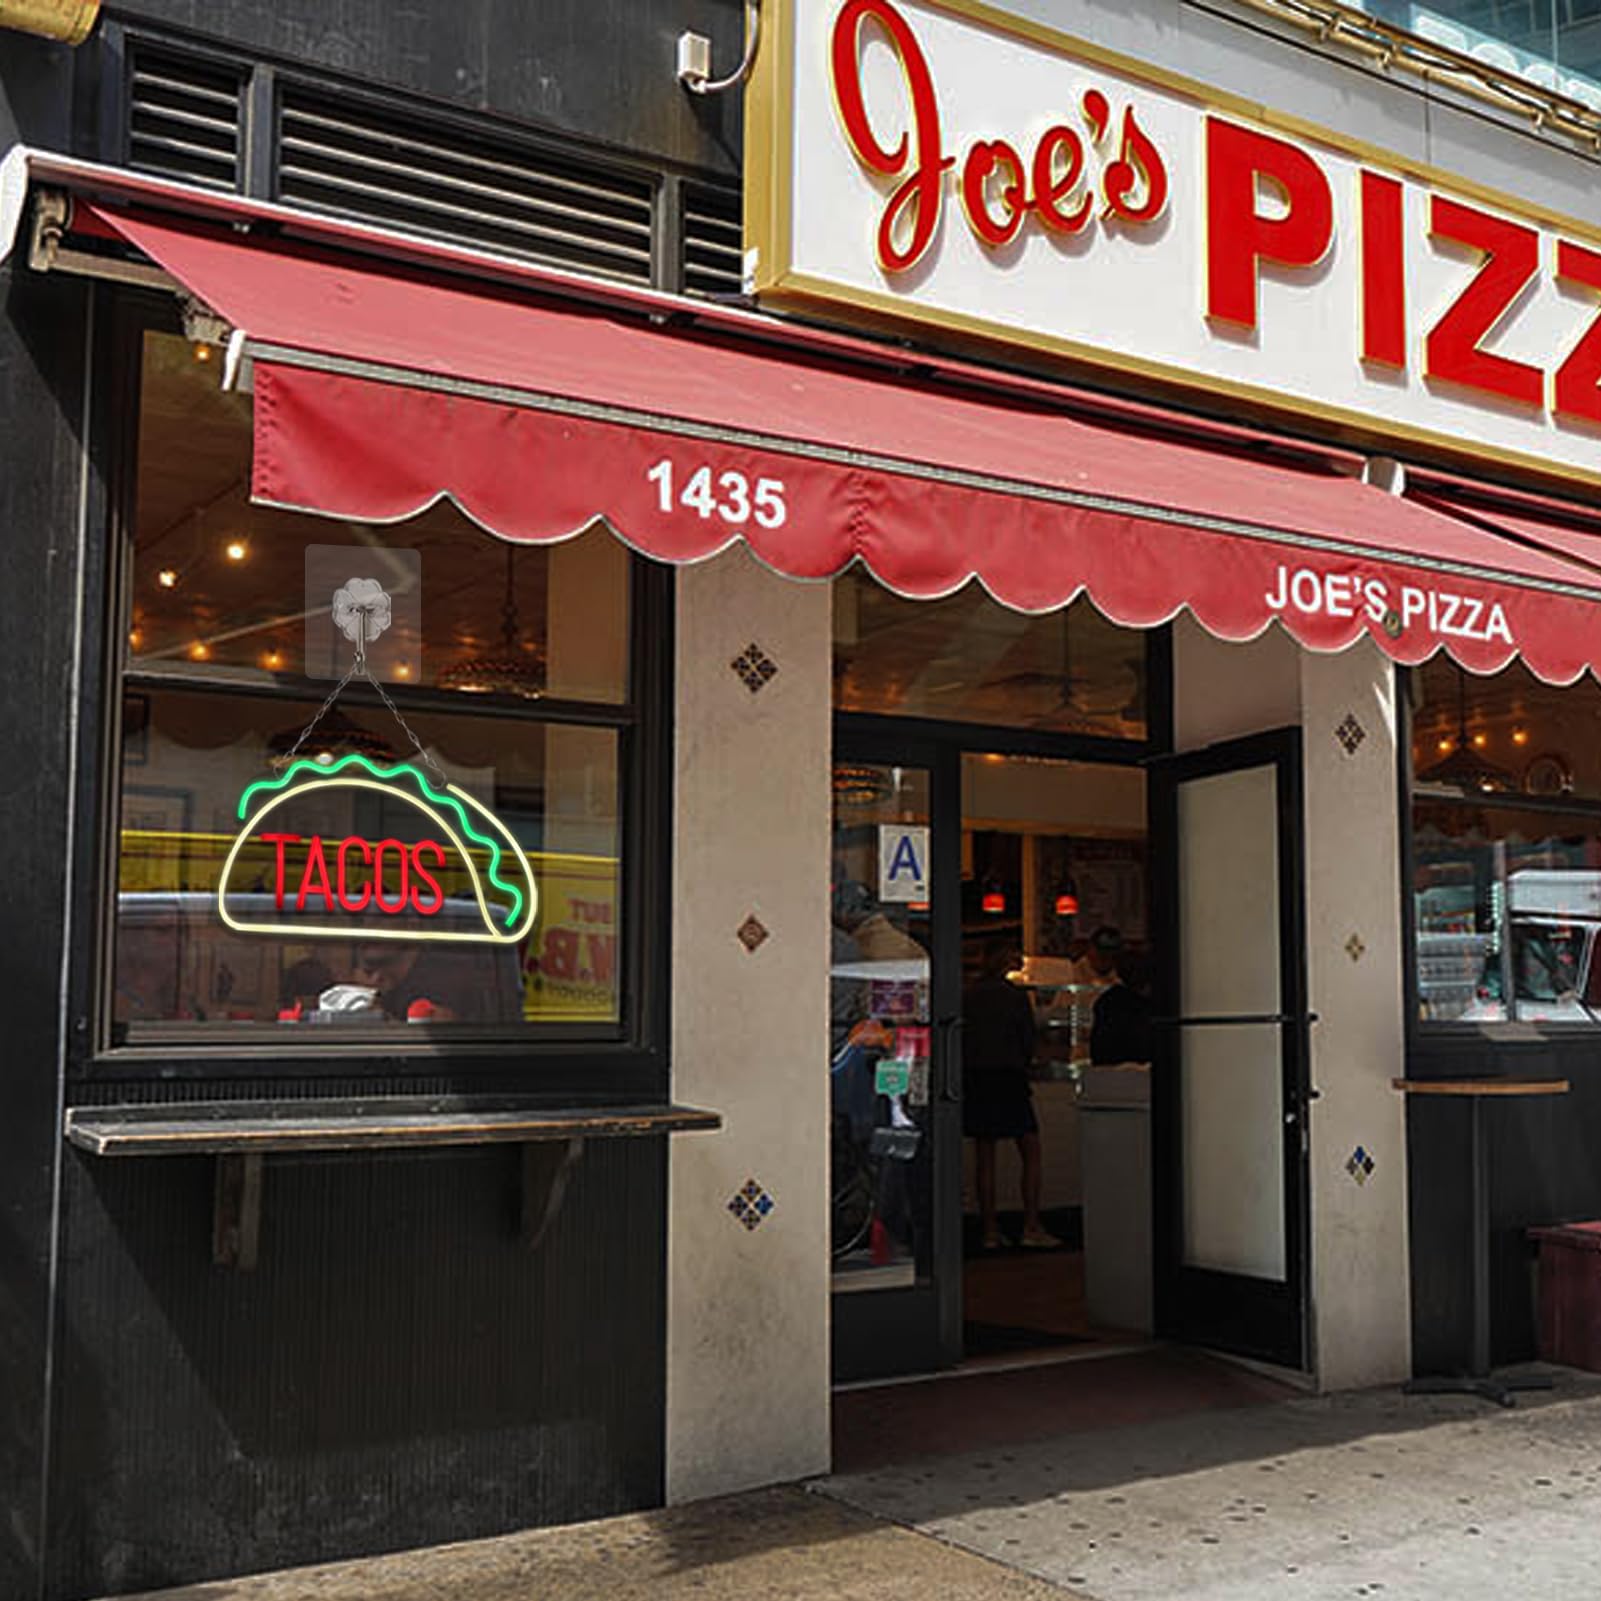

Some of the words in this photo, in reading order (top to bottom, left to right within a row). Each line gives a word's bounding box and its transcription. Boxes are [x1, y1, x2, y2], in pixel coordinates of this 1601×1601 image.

[831, 0, 1169, 273] Joe's
[647, 459, 787, 529] 1435
[1265, 565, 1389, 624] JOE'S
[1401, 586, 1514, 645] PIZZA
[259, 833, 446, 915] TACOS
[887, 835, 922, 881] A
